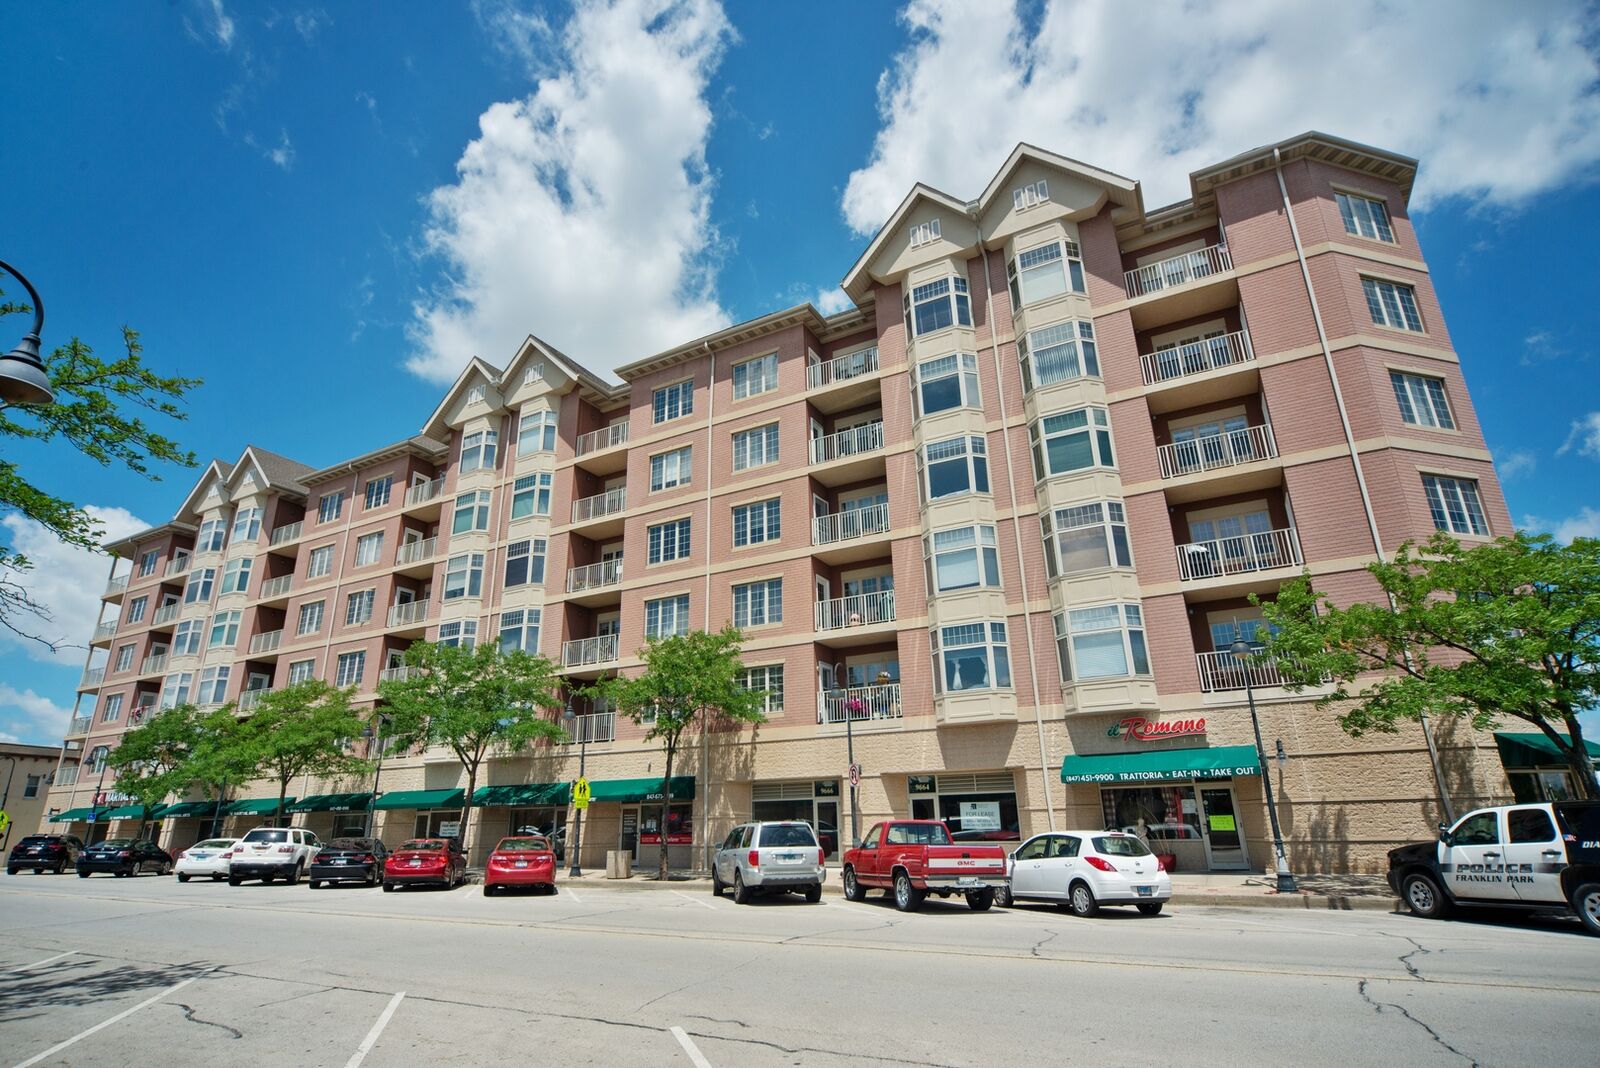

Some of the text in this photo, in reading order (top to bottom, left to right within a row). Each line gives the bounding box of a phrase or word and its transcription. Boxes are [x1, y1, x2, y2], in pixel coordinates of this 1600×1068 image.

[1120, 716, 1207, 743] Romano
[1081, 773, 1115, 782] 451-9900
[1120, 771, 1164, 780] TRATTORIA
[1172, 769, 1201, 778] EAT-IN
[1209, 768, 1232, 777] TAKE
[1235, 766, 1255, 775] OUT
[1456, 863, 1534, 874] POLICE
[1455, 874, 1535, 884] FRANKLIN PARK
